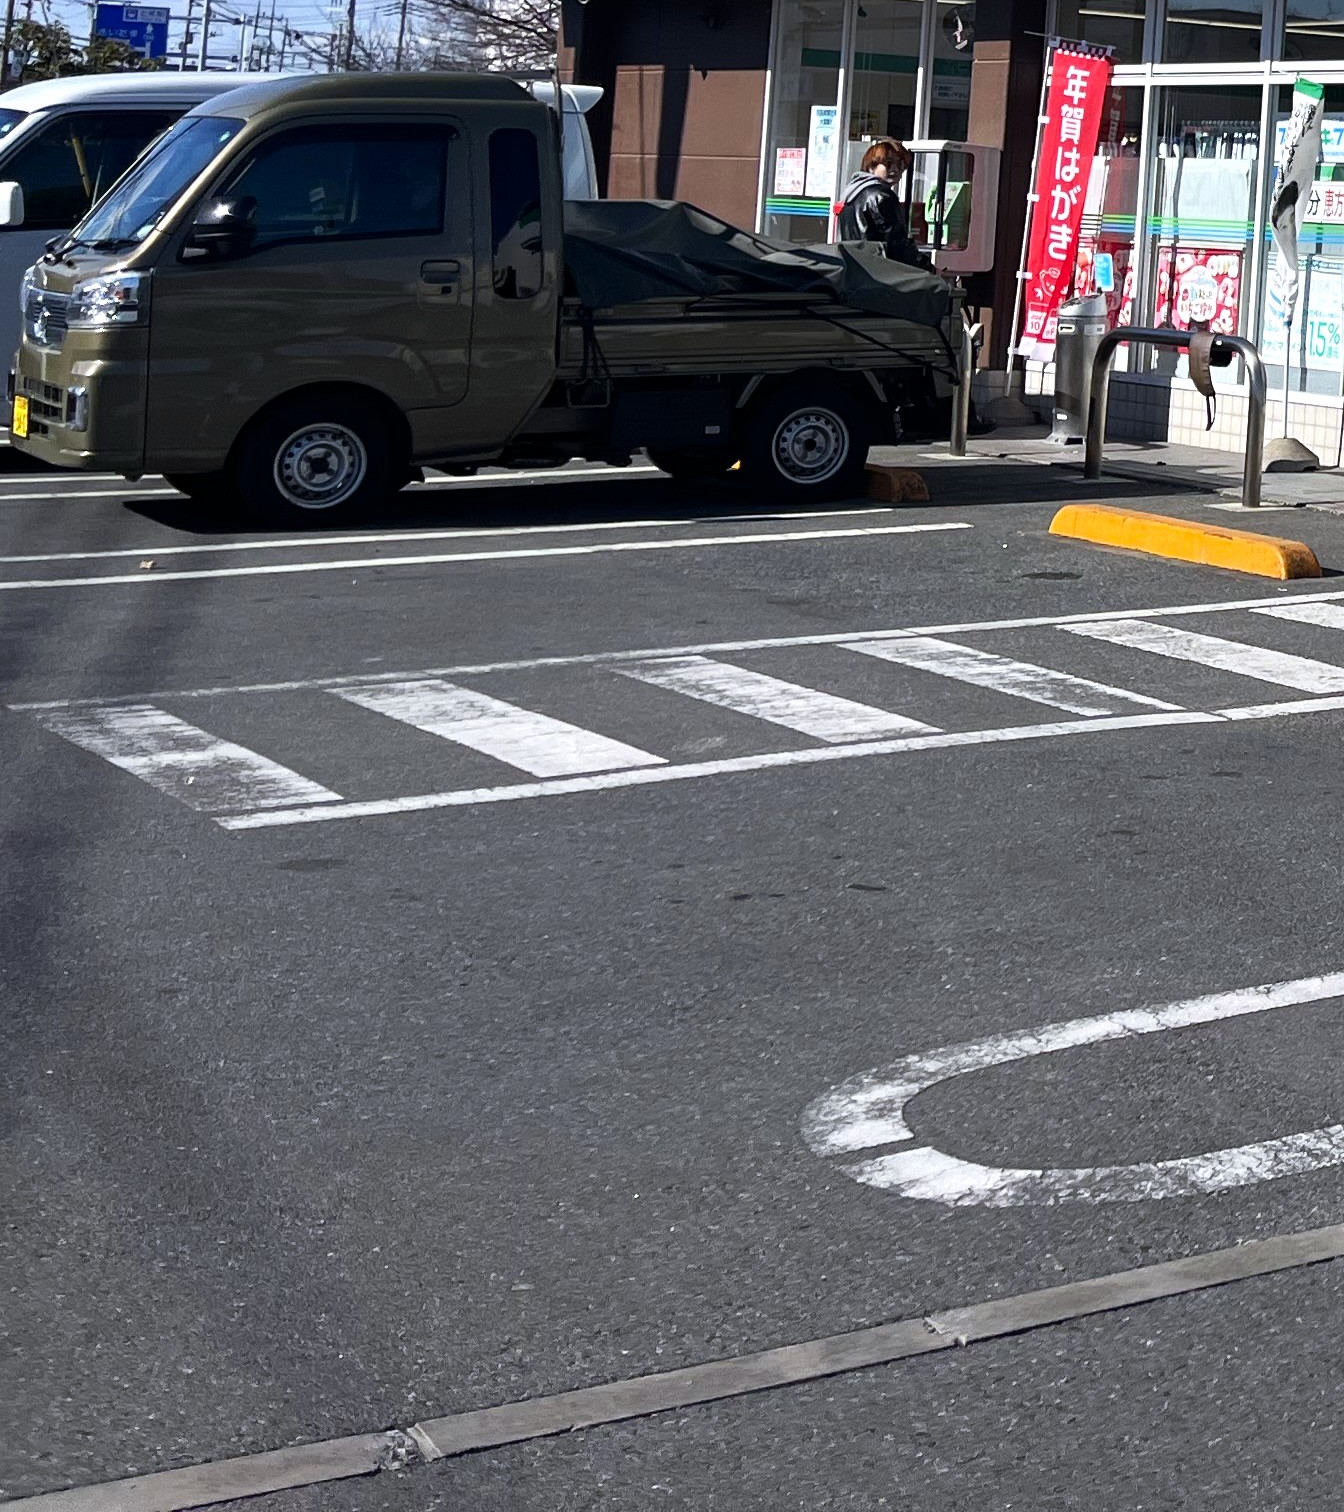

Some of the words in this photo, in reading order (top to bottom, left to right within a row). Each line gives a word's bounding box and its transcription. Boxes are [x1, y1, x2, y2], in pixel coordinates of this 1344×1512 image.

[1048, 65, 1090, 261] 年賀はがき
